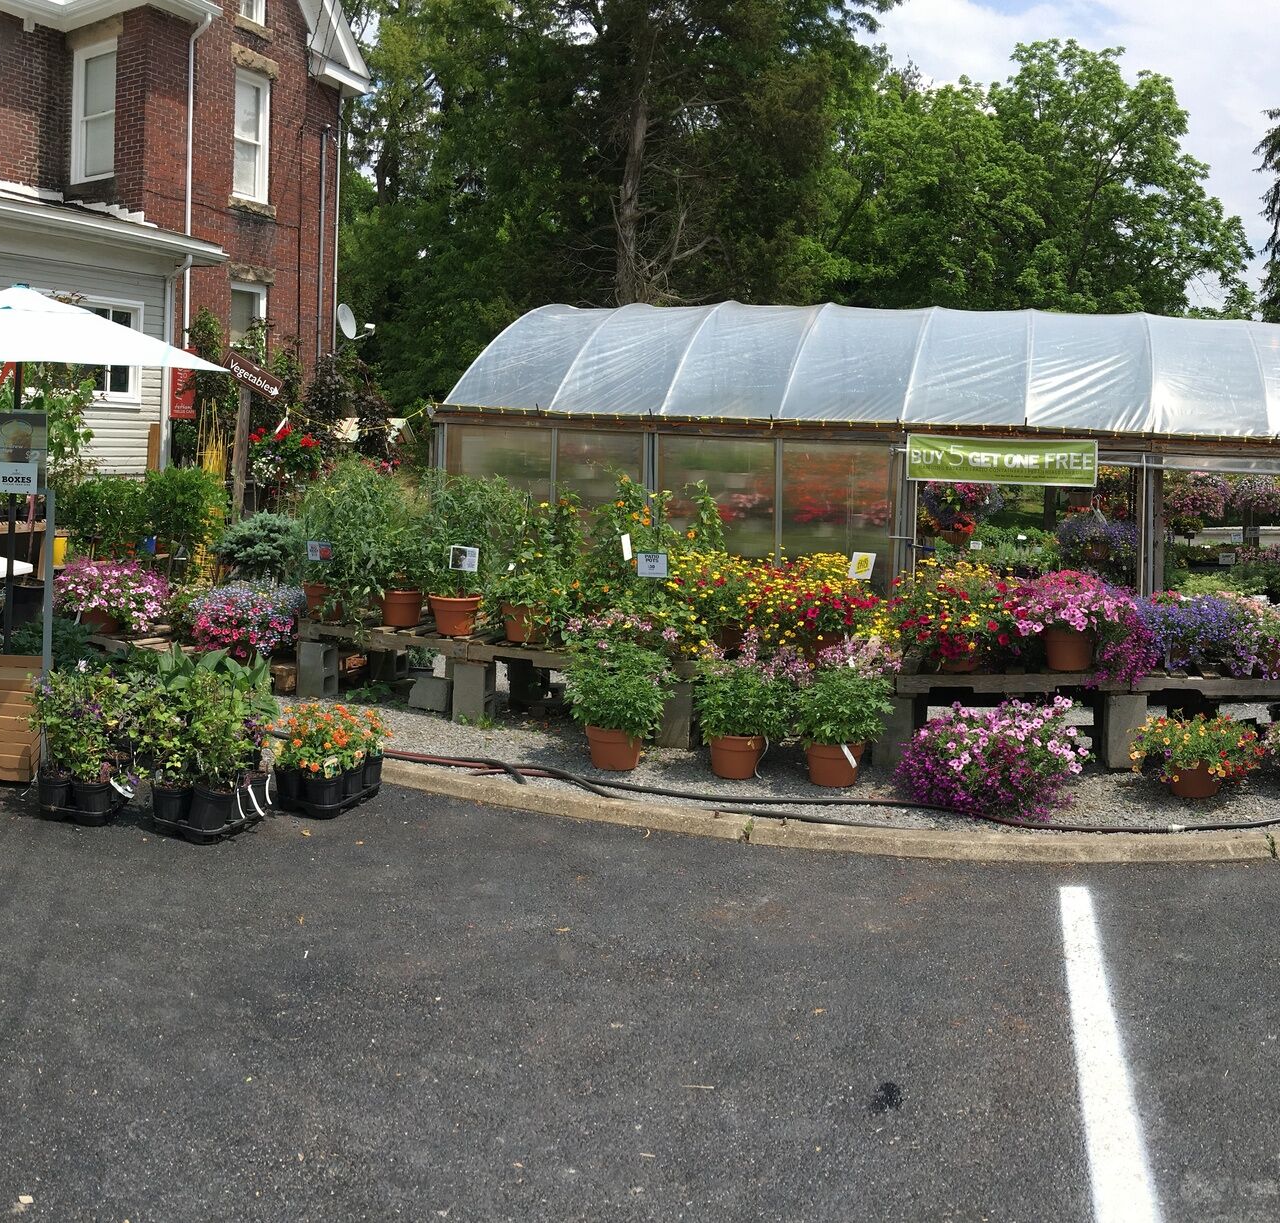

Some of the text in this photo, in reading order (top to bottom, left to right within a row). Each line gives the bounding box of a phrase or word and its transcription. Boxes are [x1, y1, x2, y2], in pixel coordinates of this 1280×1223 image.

[230, 359, 274, 394] Vegetables
[911, 445, 1094, 470] BUY 5 GET ONE FREE
